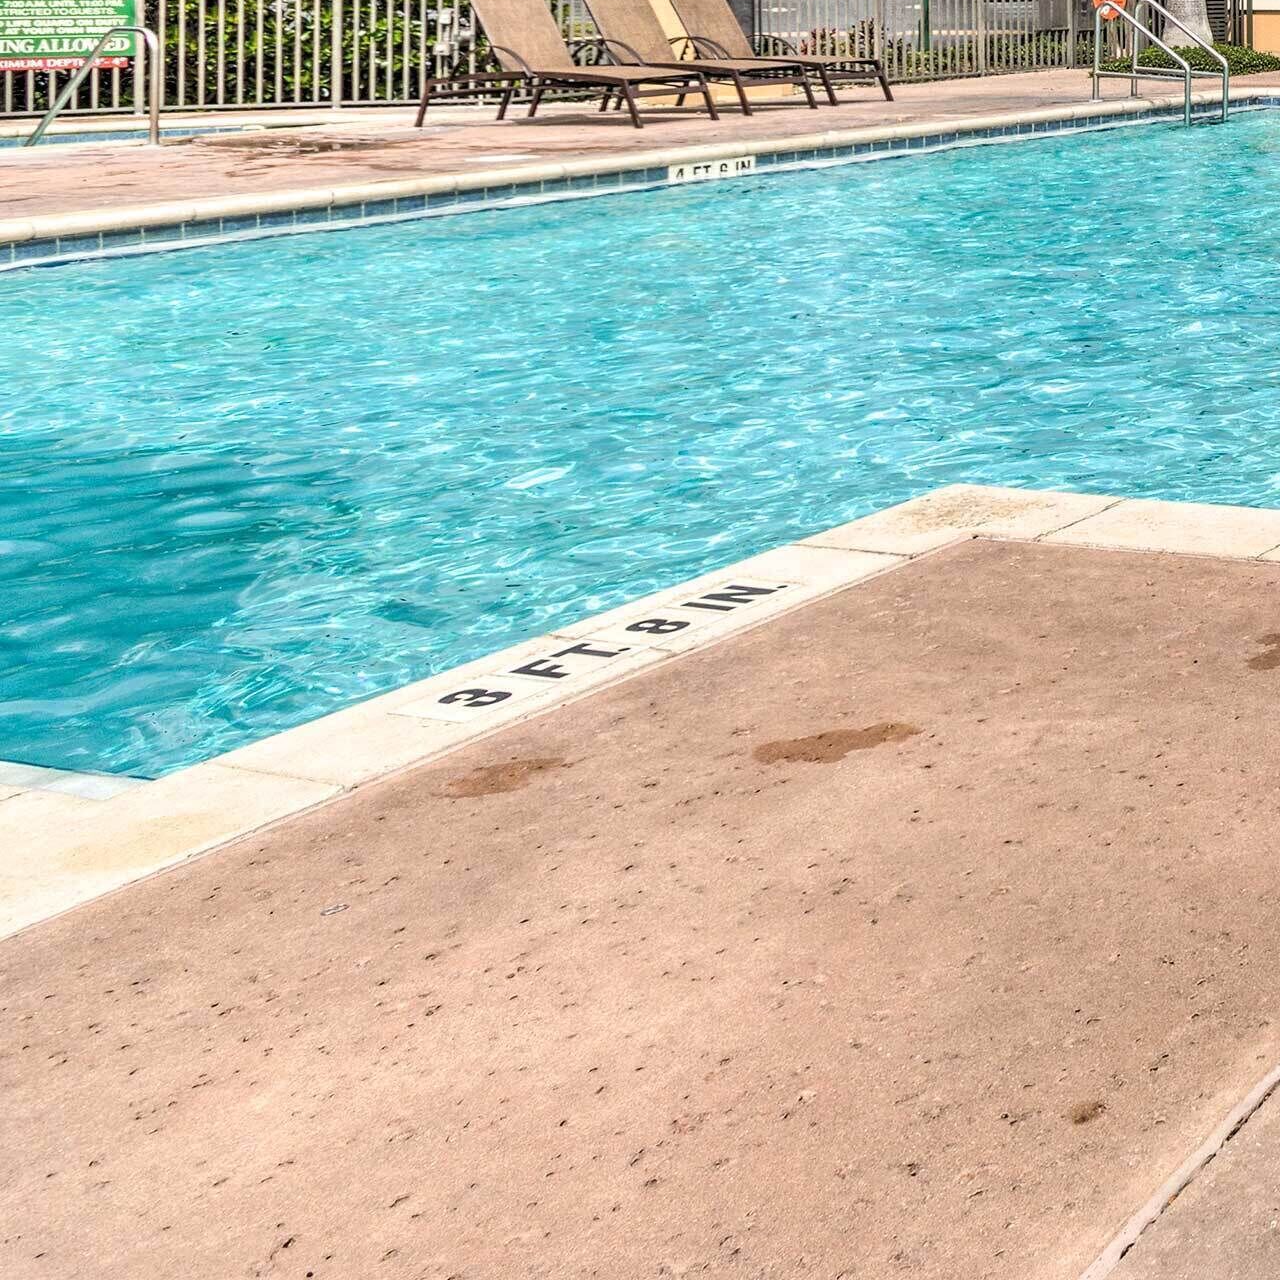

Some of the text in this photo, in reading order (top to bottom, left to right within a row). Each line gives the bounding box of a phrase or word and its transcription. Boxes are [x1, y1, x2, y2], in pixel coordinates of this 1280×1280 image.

[693, 165, 711, 175] FT
[437, 584, 789, 708] 3 FT. 8 IN.
